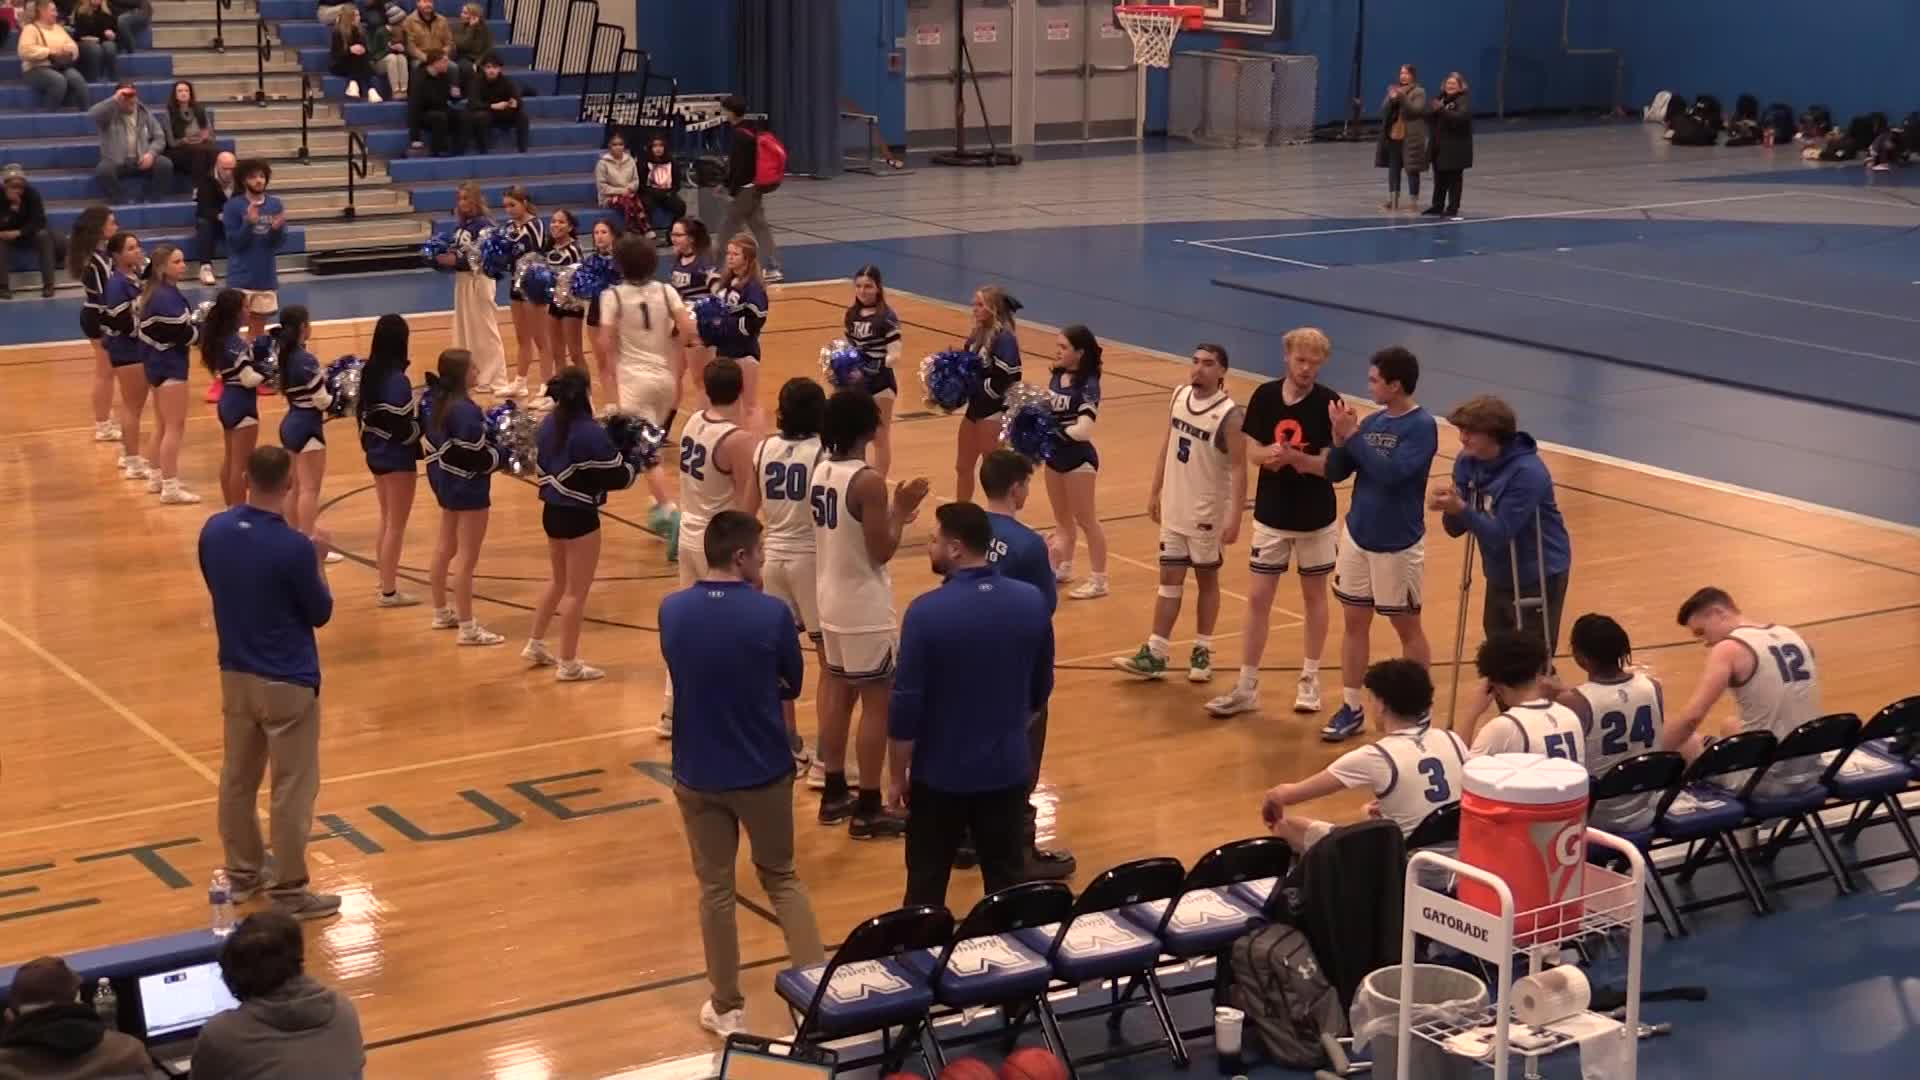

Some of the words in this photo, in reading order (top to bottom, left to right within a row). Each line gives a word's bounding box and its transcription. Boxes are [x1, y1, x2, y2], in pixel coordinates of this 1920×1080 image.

[640, 302, 651, 330] 1
[680, 436, 707, 481] 22
[1177, 436, 1192, 464] 5
[765, 461, 807, 501] 20
[811, 485, 838, 530] 50
[1768, 643, 1810, 683] 12
[1544, 731, 1579, 762] 51
[1601, 705, 1655, 756] 24
[1418, 757, 1451, 803] 3
[1555, 823, 1582, 866] G
[1422, 906, 1489, 943] GATORADE
